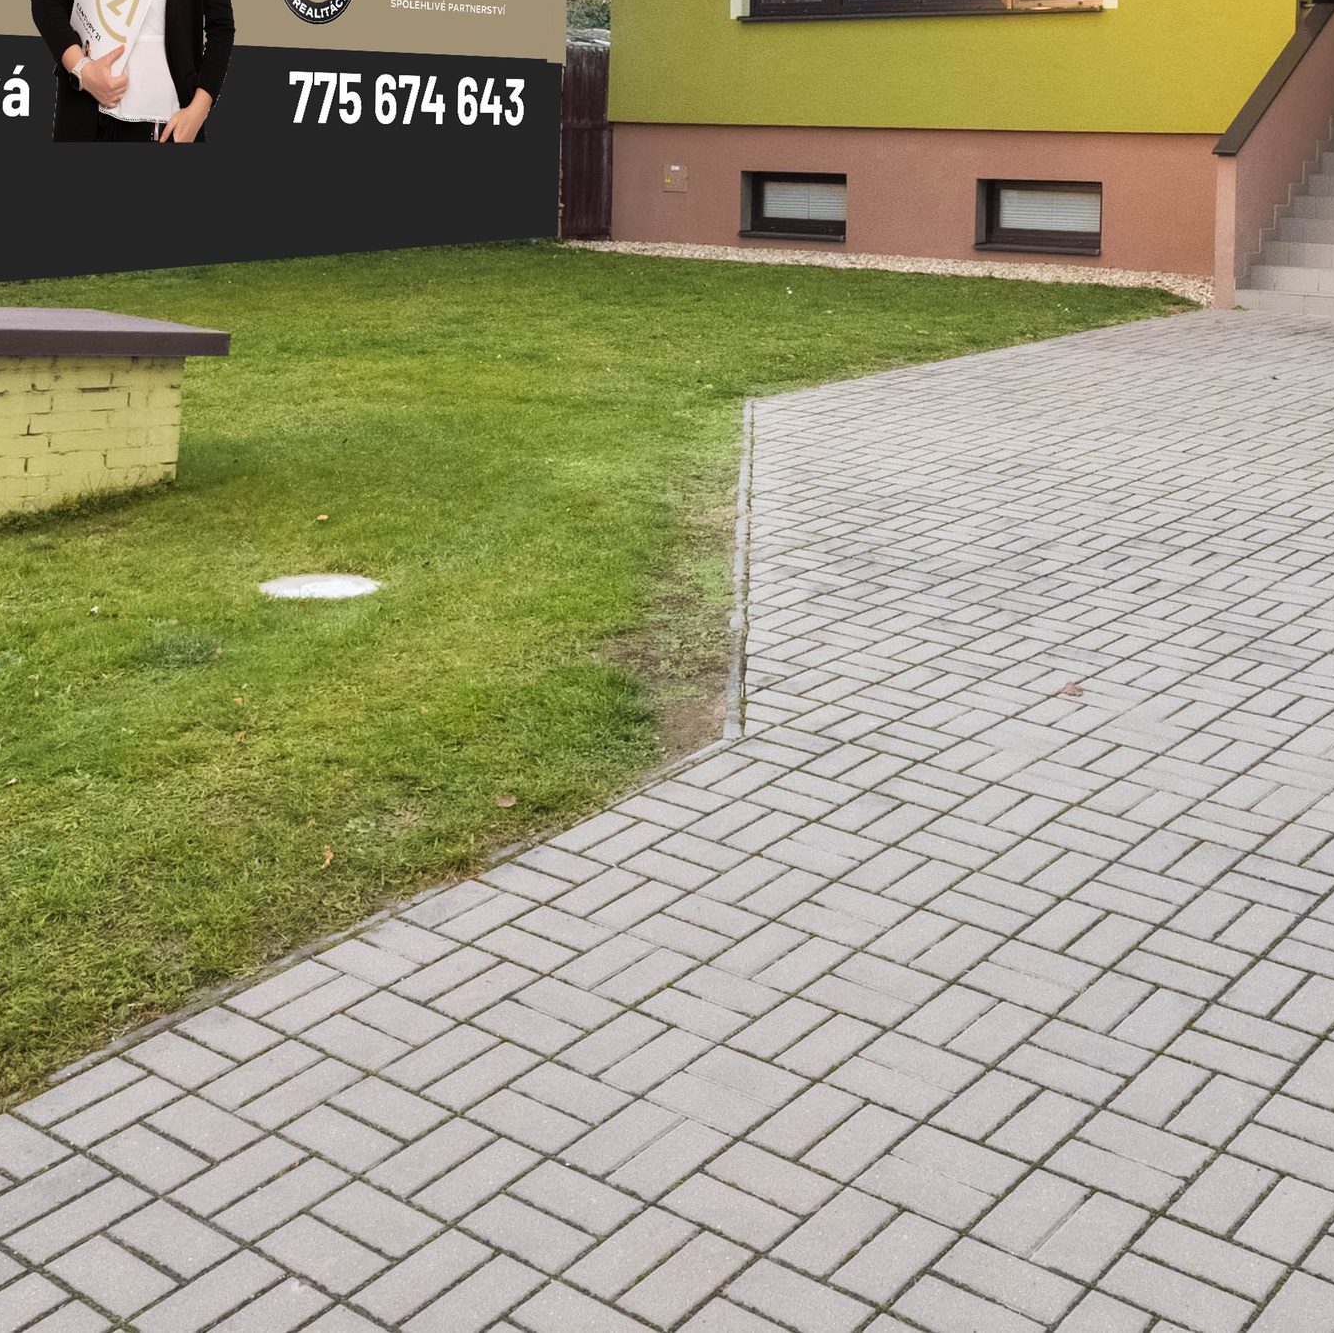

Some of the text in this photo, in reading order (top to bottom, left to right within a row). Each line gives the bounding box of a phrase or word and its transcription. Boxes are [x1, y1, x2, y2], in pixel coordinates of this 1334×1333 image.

[448, 3, 507, 16] PARTNERSTVÍ
[288, 71, 526, 127] 775 674 643
